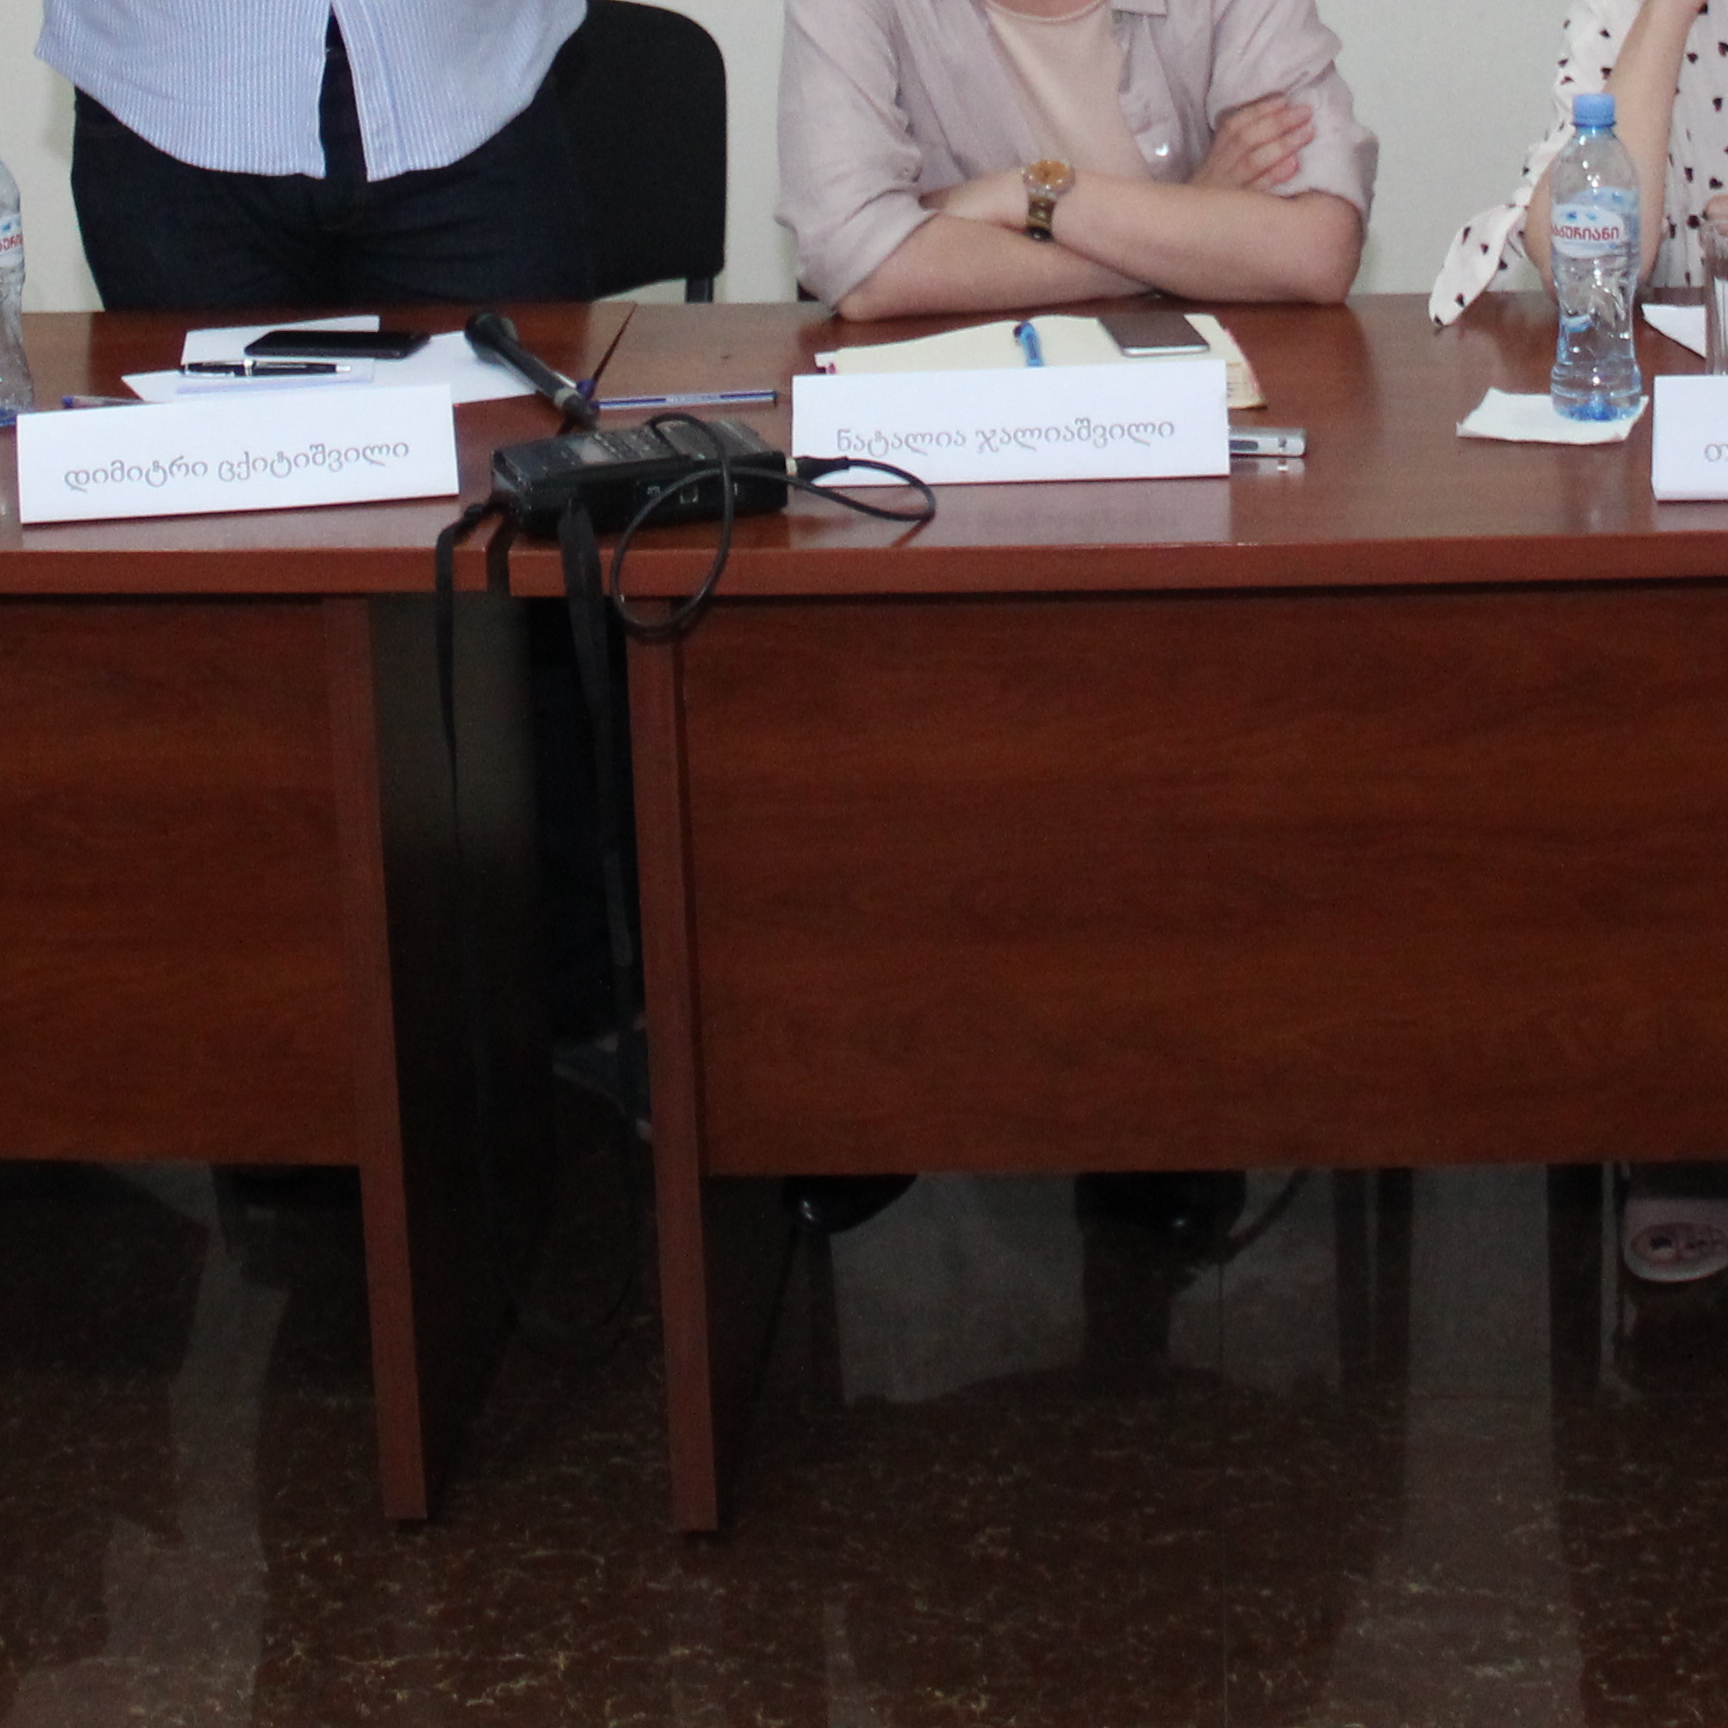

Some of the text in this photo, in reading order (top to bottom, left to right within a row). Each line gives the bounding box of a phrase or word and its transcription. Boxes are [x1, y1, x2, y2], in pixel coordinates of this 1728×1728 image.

[836, 416, 1176, 457] ნატალია ჯალიაშვილი
[63, 441, 410, 494] დიმიტრი ცქიტიშვილი
